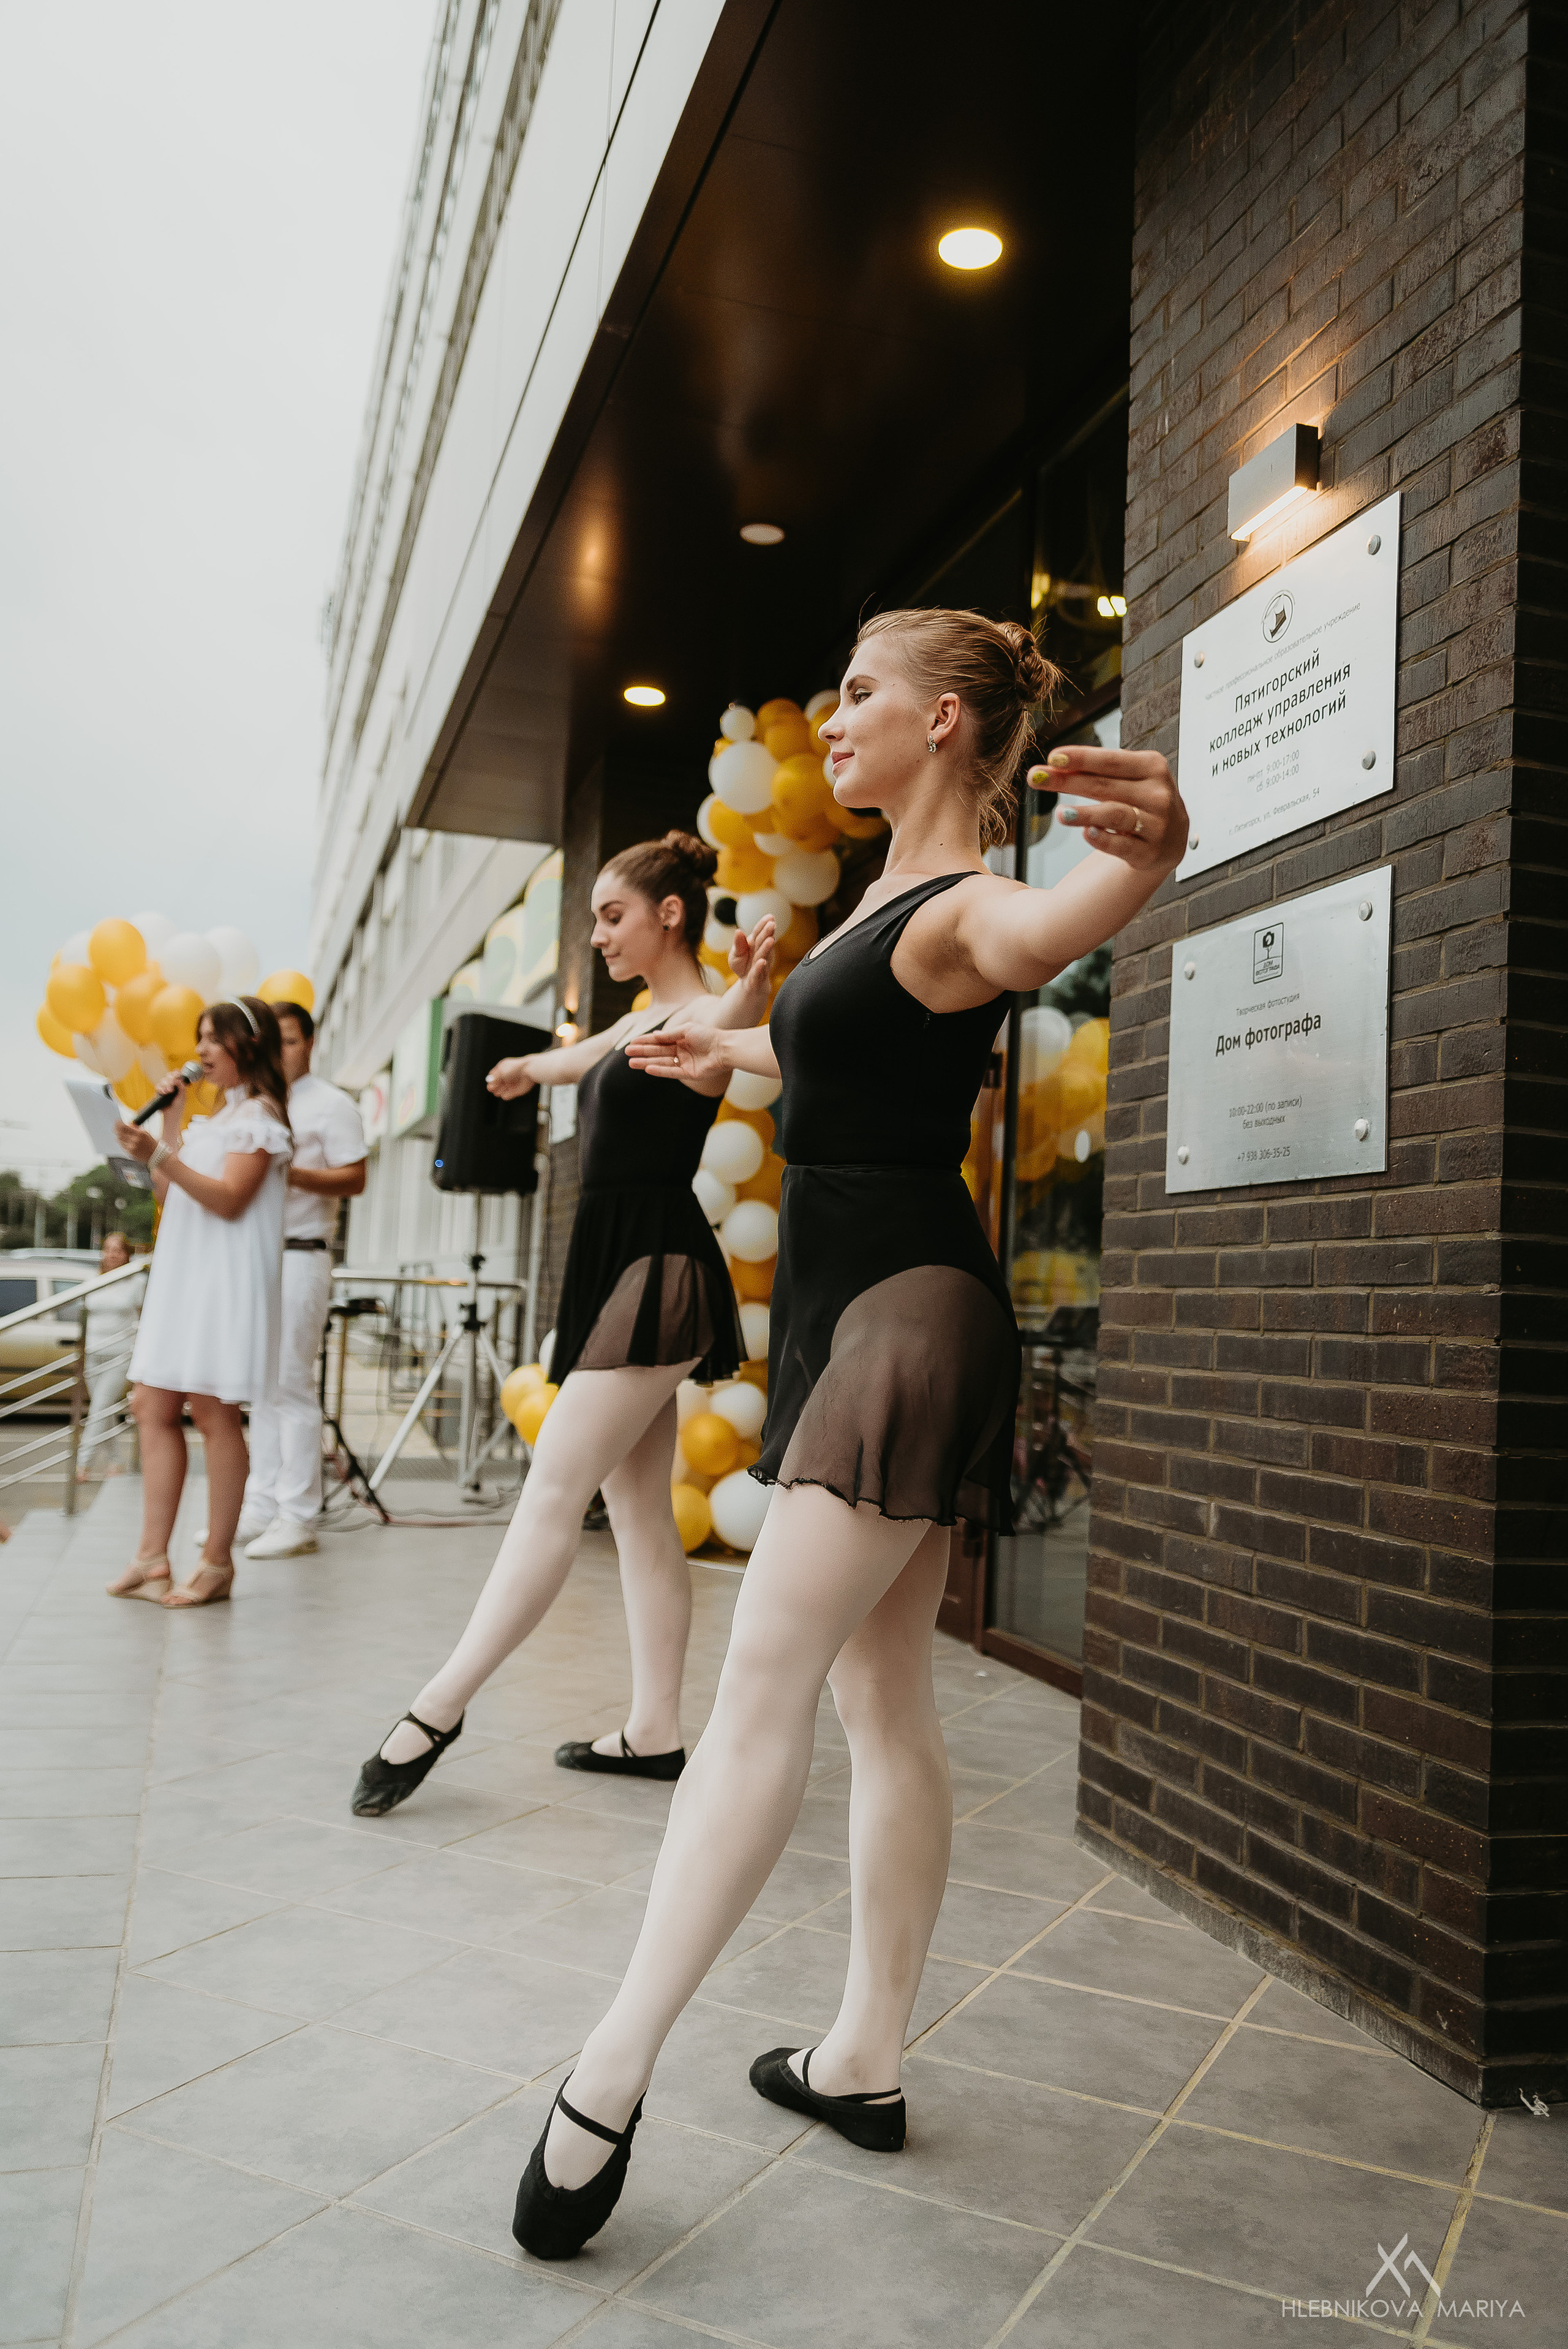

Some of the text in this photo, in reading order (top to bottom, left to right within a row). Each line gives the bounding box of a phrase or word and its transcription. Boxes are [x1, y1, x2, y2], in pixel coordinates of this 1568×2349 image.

[1274, 625, 1322, 660] образовательное
[1324, 602, 1361, 632] учреждение
[1235, 648, 1320, 713] Пятигорский
[1210, 663, 1351, 753] колледж управления
[1212, 689, 1346, 777] и новых технологий
[1266, 749, 1300, 774] 9:00-17:00
[1256, 763, 1299, 793] сб 9:00-14:00
[1273, 793, 1311, 815] Февральская,
[1313, 787, 1320, 798] 54
[1267, 993, 1300, 1009] фотостудия
[1215, 1012, 1322, 1057] Дом фотографа
[1265, 1101, 1276, 1114] (по
[1277, 1094, 1303, 1110] записи)
[1243, 1119, 1253, 1130] без
